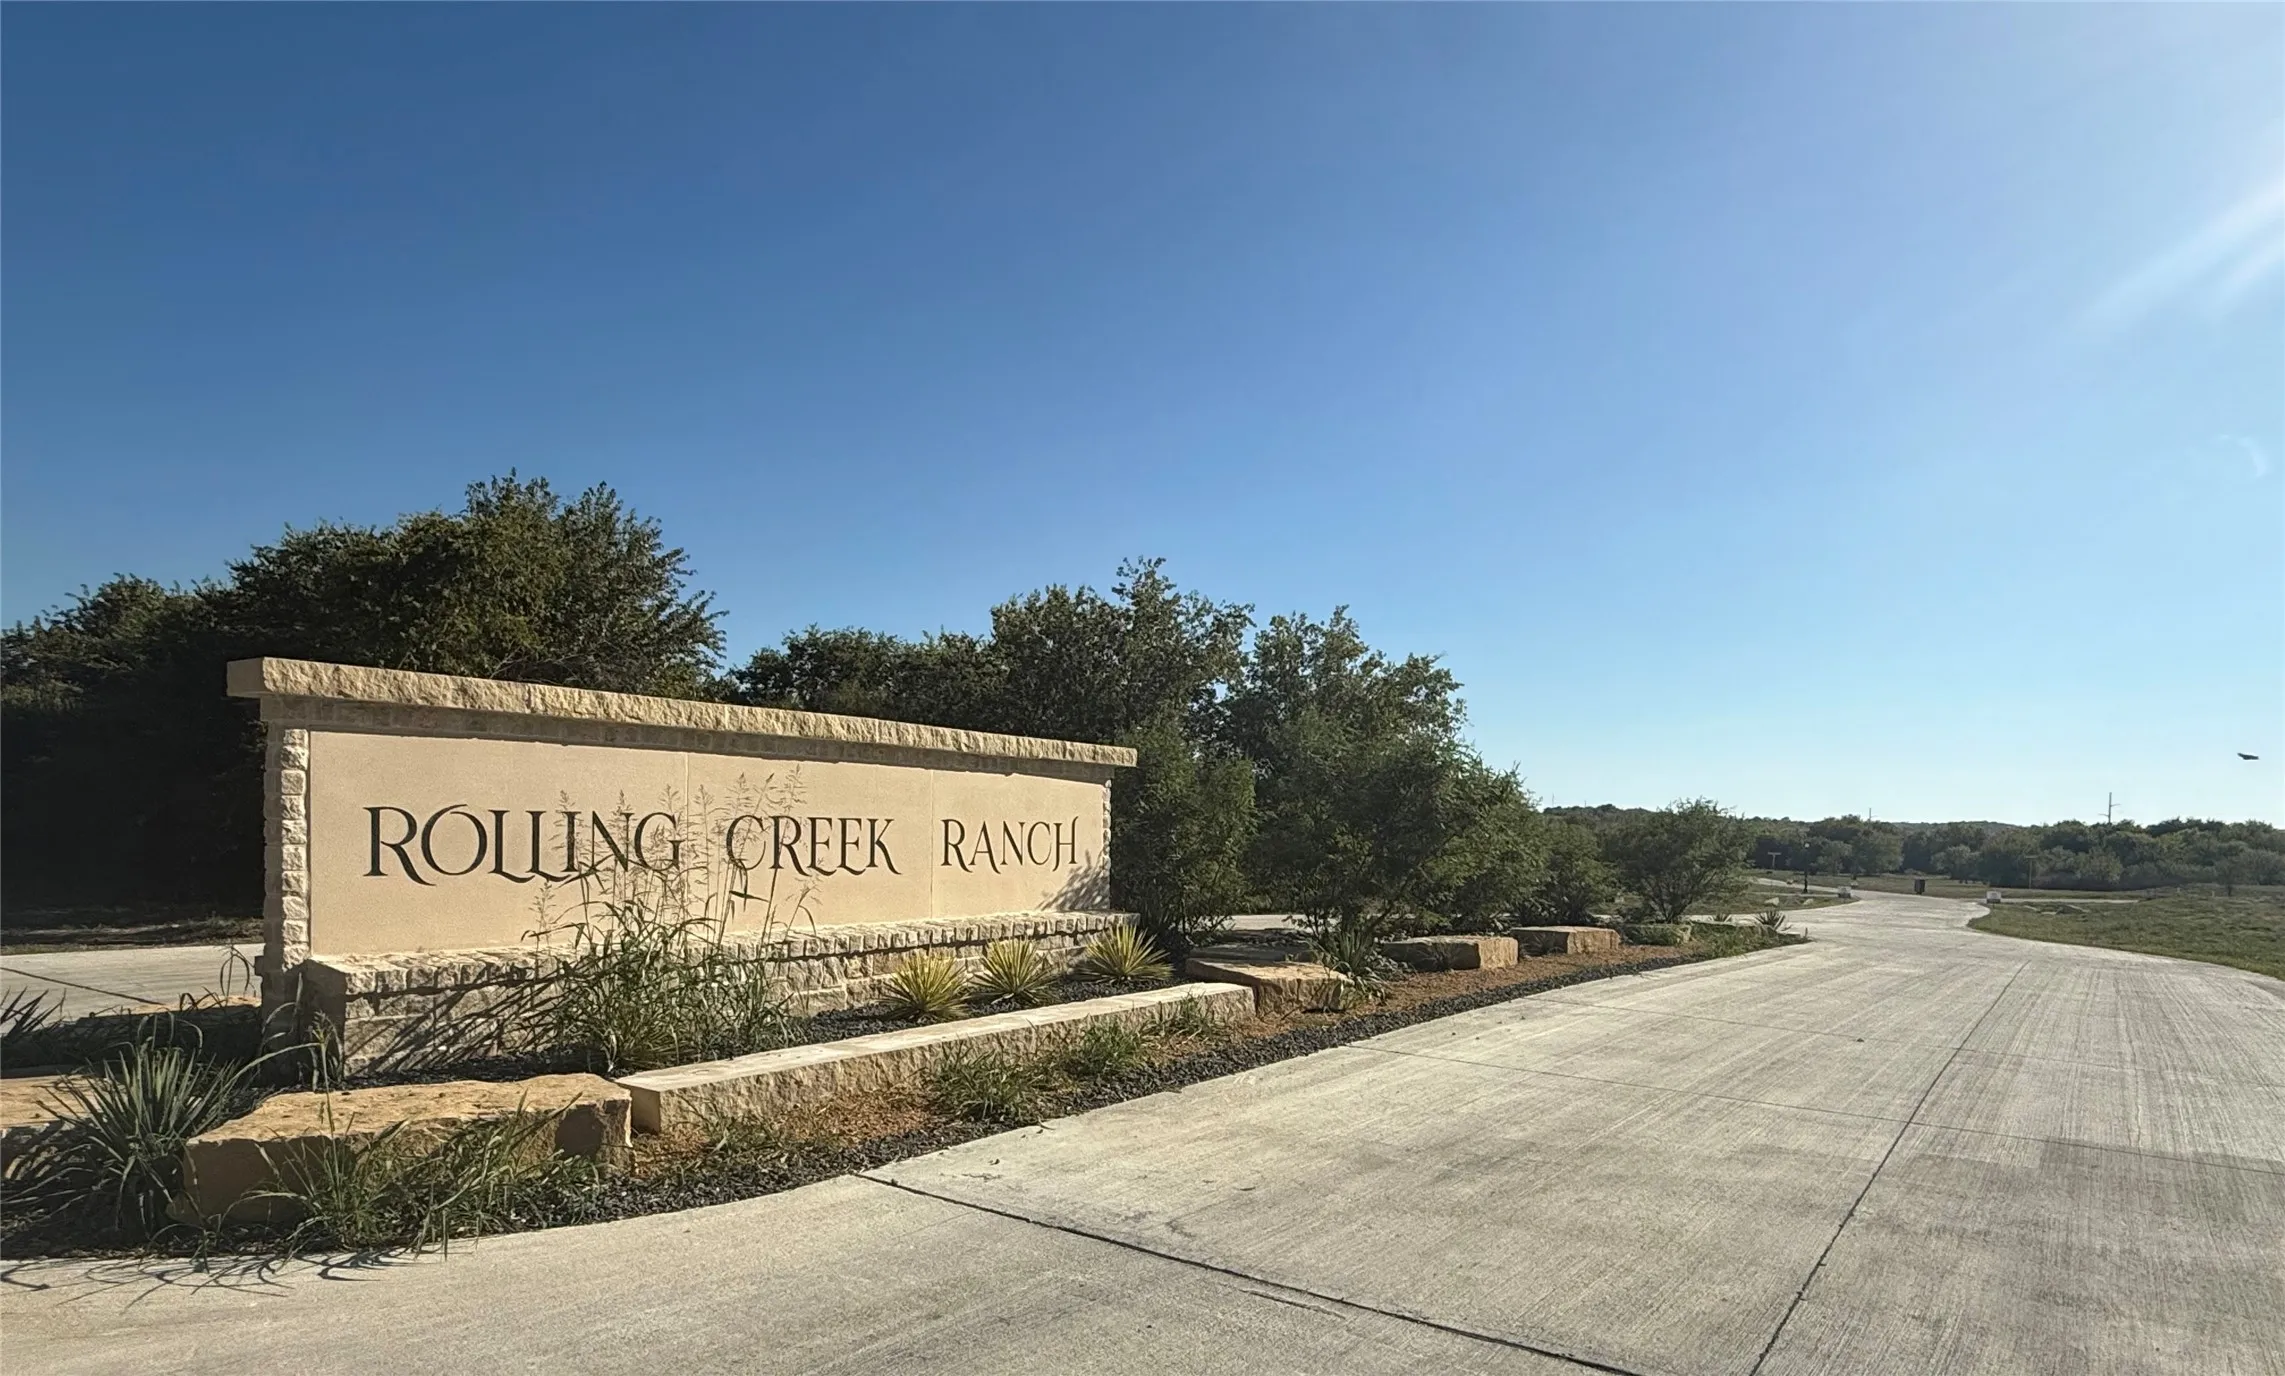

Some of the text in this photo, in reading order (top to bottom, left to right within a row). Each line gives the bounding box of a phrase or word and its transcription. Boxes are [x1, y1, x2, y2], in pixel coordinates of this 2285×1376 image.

[362, 803, 1080, 887] ROLLING CREEK RANCH
